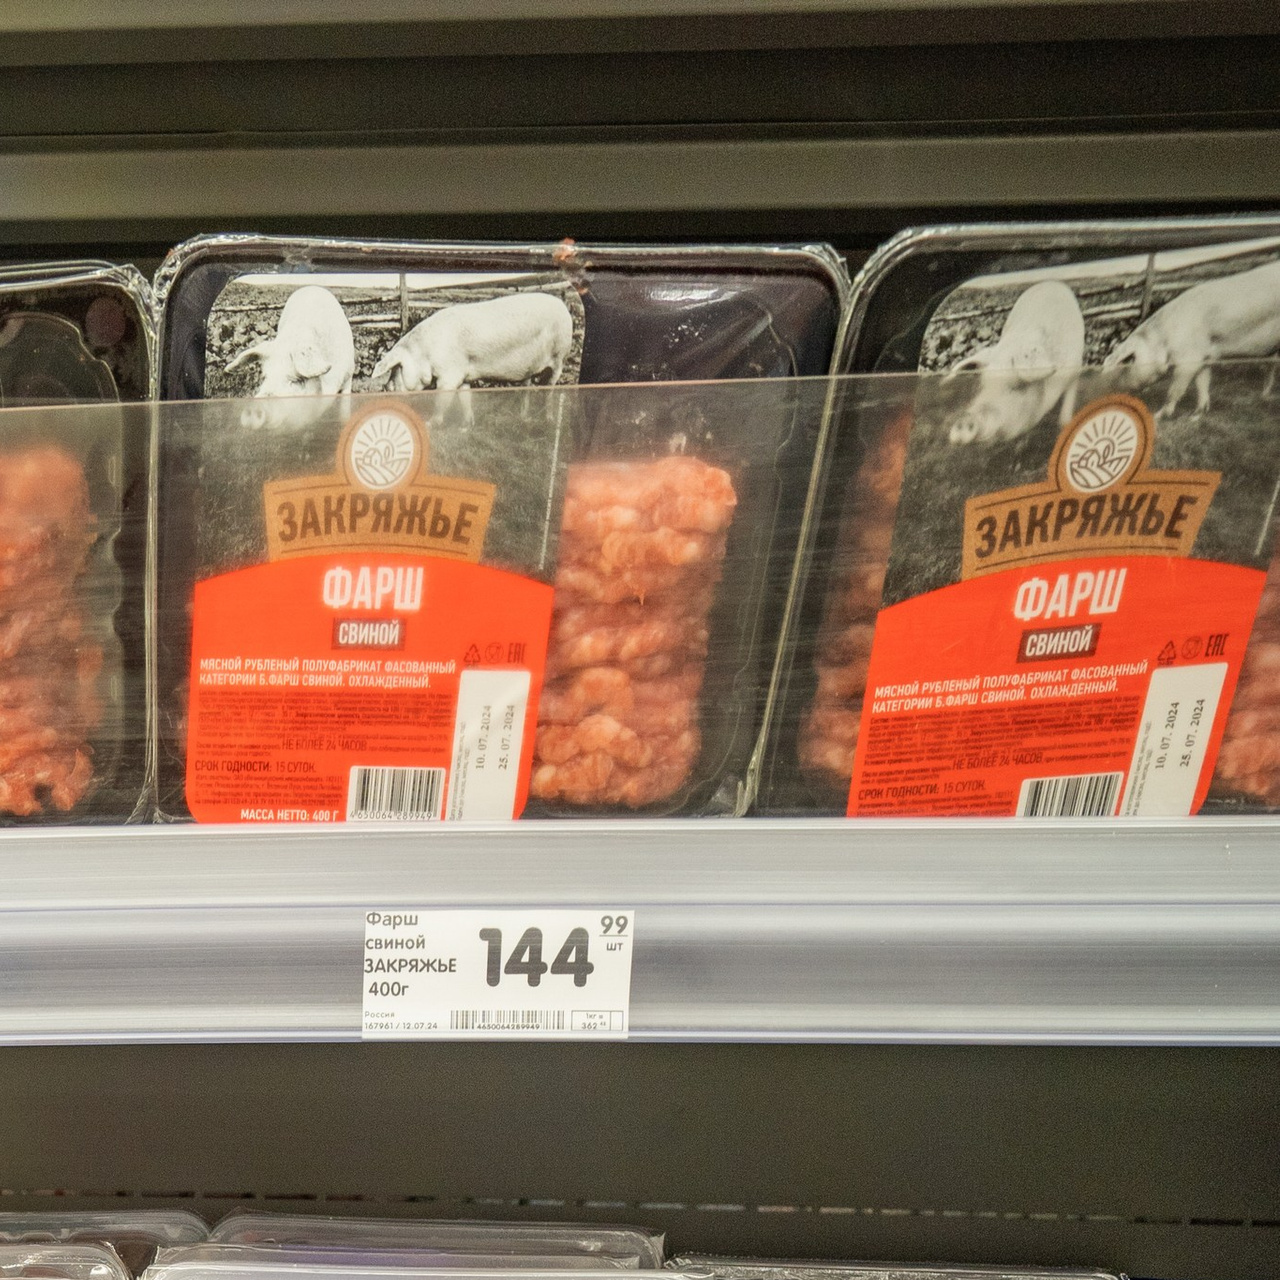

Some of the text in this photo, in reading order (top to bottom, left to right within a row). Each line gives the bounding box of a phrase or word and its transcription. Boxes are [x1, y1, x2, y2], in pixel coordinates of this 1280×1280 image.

[276, 492, 481, 544] ЗАКРЯЖЬЕ
[974, 494, 1199, 559] ЗАКРЯЖЬЕ
[322, 565, 424, 613] ФАРШ
[1012, 567, 1128, 622] ФАРШ
[338, 624, 400, 646] СВИНОЙ
[1025, 627, 1094, 657] СВИНОЙ
[200, 657, 456, 675] МЯСНОЙ РУБЛЕНЫЙ ПОЛУФАБРИКАТ ФАСОВАННЫЙ
[199, 674, 256, 686] КАТЕГОРИИ
[875, 660, 1148, 698] МЯСНОЙ РУБЛЕНЫЙ ПОЛУФАБРИКАТ ФАСОВАННЫЙ
[872, 696, 933, 714] КАТЕГОРИИ
[282, 740, 336, 751] НЕ БОЛЕЕ 24
[195, 760, 285, 773] СРОК 15
[858, 782, 953, 800] СРОК 15
[241, 809, 331, 821] МАССА 400
[366, 912, 418, 930] Фарш
[366, 935, 426, 950] свиной
[479, 915, 628, 987] 144 99
[606, 941, 624, 952] шт
[364, 958, 457, 974] ЗАКРЯЖЬЕ
[368, 982, 409, 996] 400г
